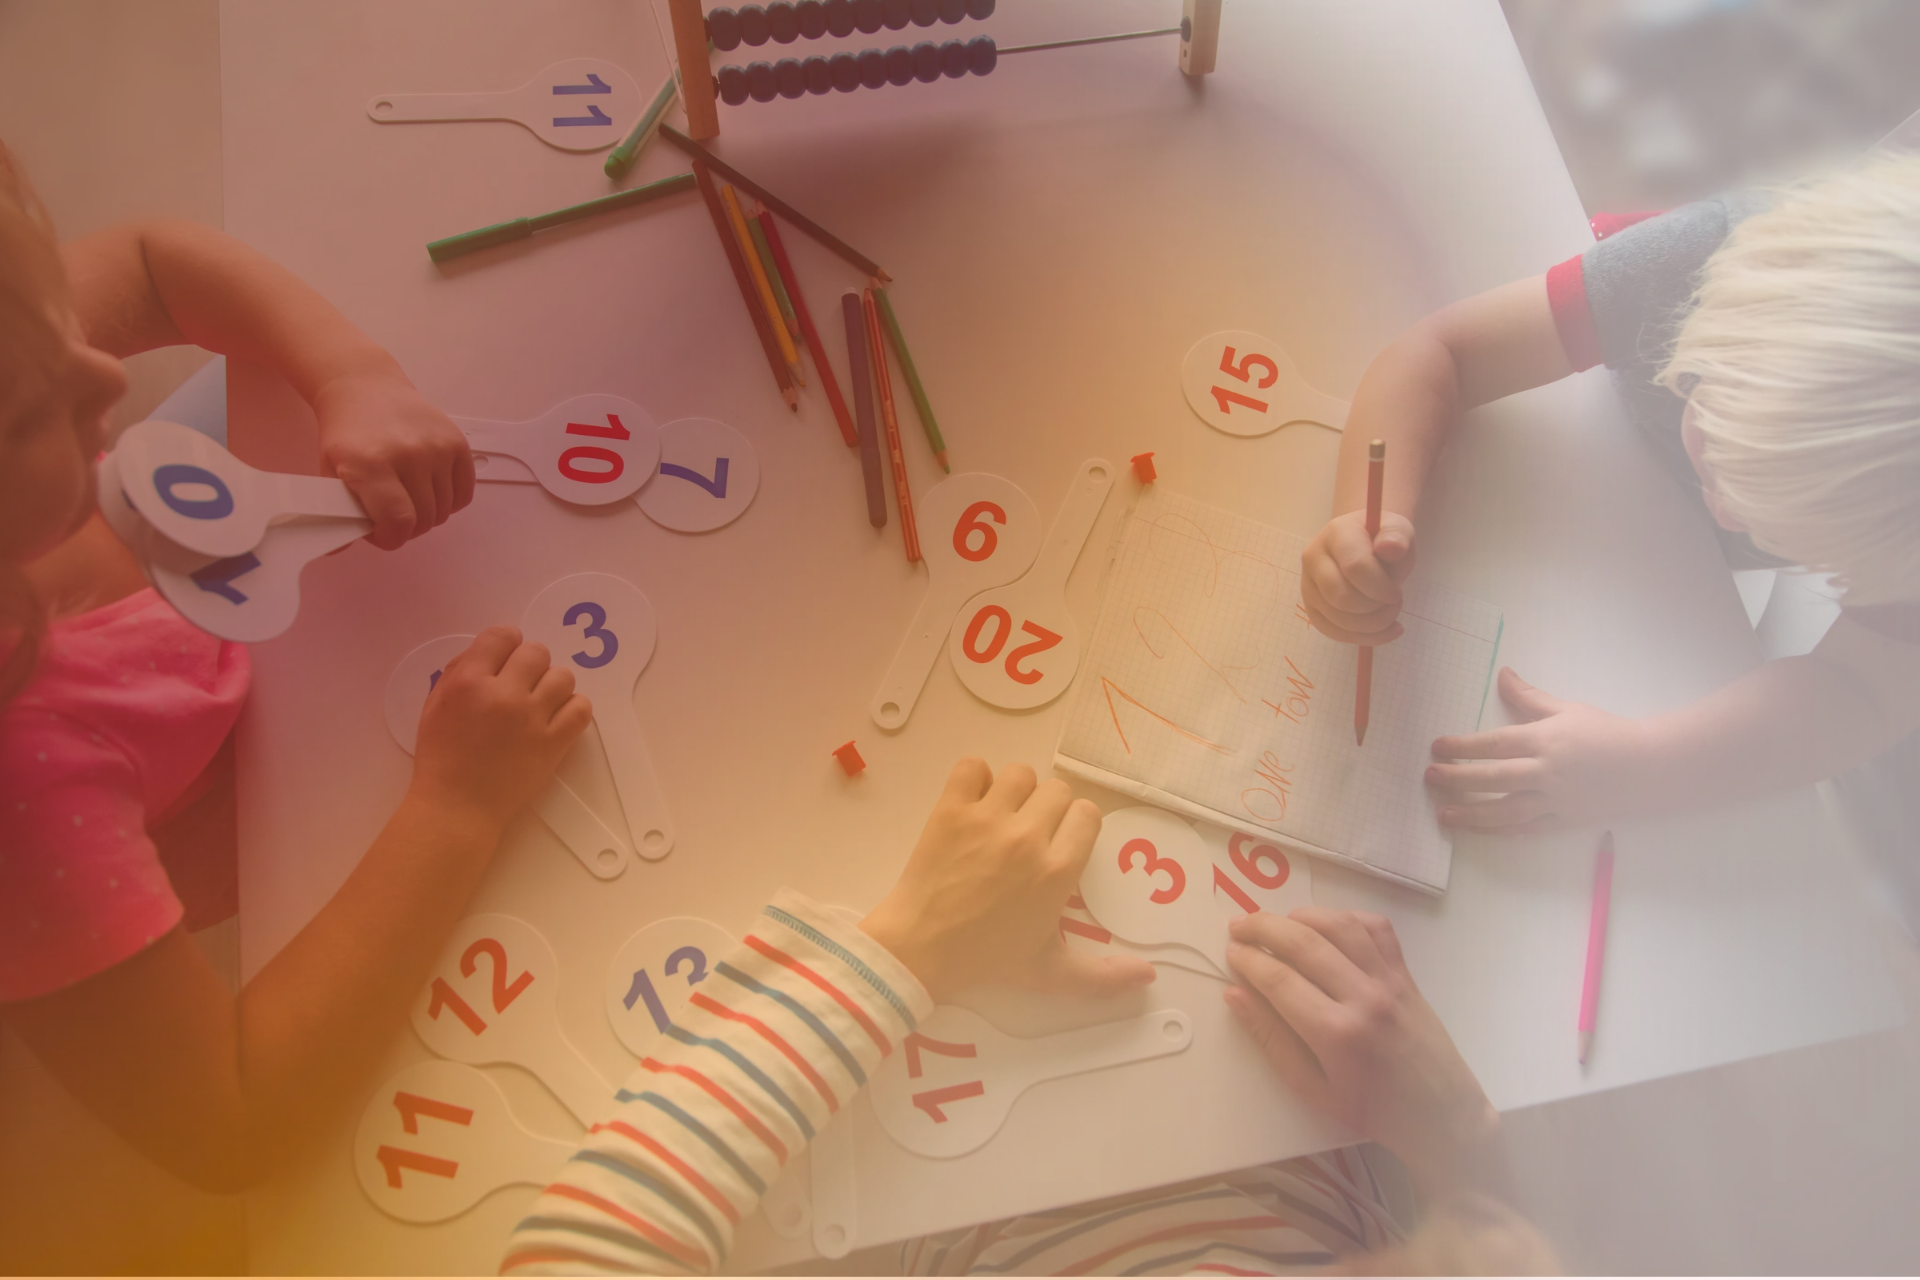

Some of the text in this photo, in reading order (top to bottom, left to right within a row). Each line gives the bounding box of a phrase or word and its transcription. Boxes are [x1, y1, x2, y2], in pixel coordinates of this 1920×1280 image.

[552, 74, 611, 127] 11
[1210, 345, 1278, 414] 15
[557, 413, 631, 484] 10
[659, 457, 729, 499] 7
[153, 464, 234, 520] 0
[563, 602, 618, 669] 3
[962, 605, 1062, 685] 20
[1118, 838, 1186, 904] 3
[1212, 831, 1290, 914] 16
[1059, 895, 1112, 944] 1
[427, 937, 535, 1036] 12
[904, 1033, 984, 1123] 17
[376, 1091, 474, 1189] 11
